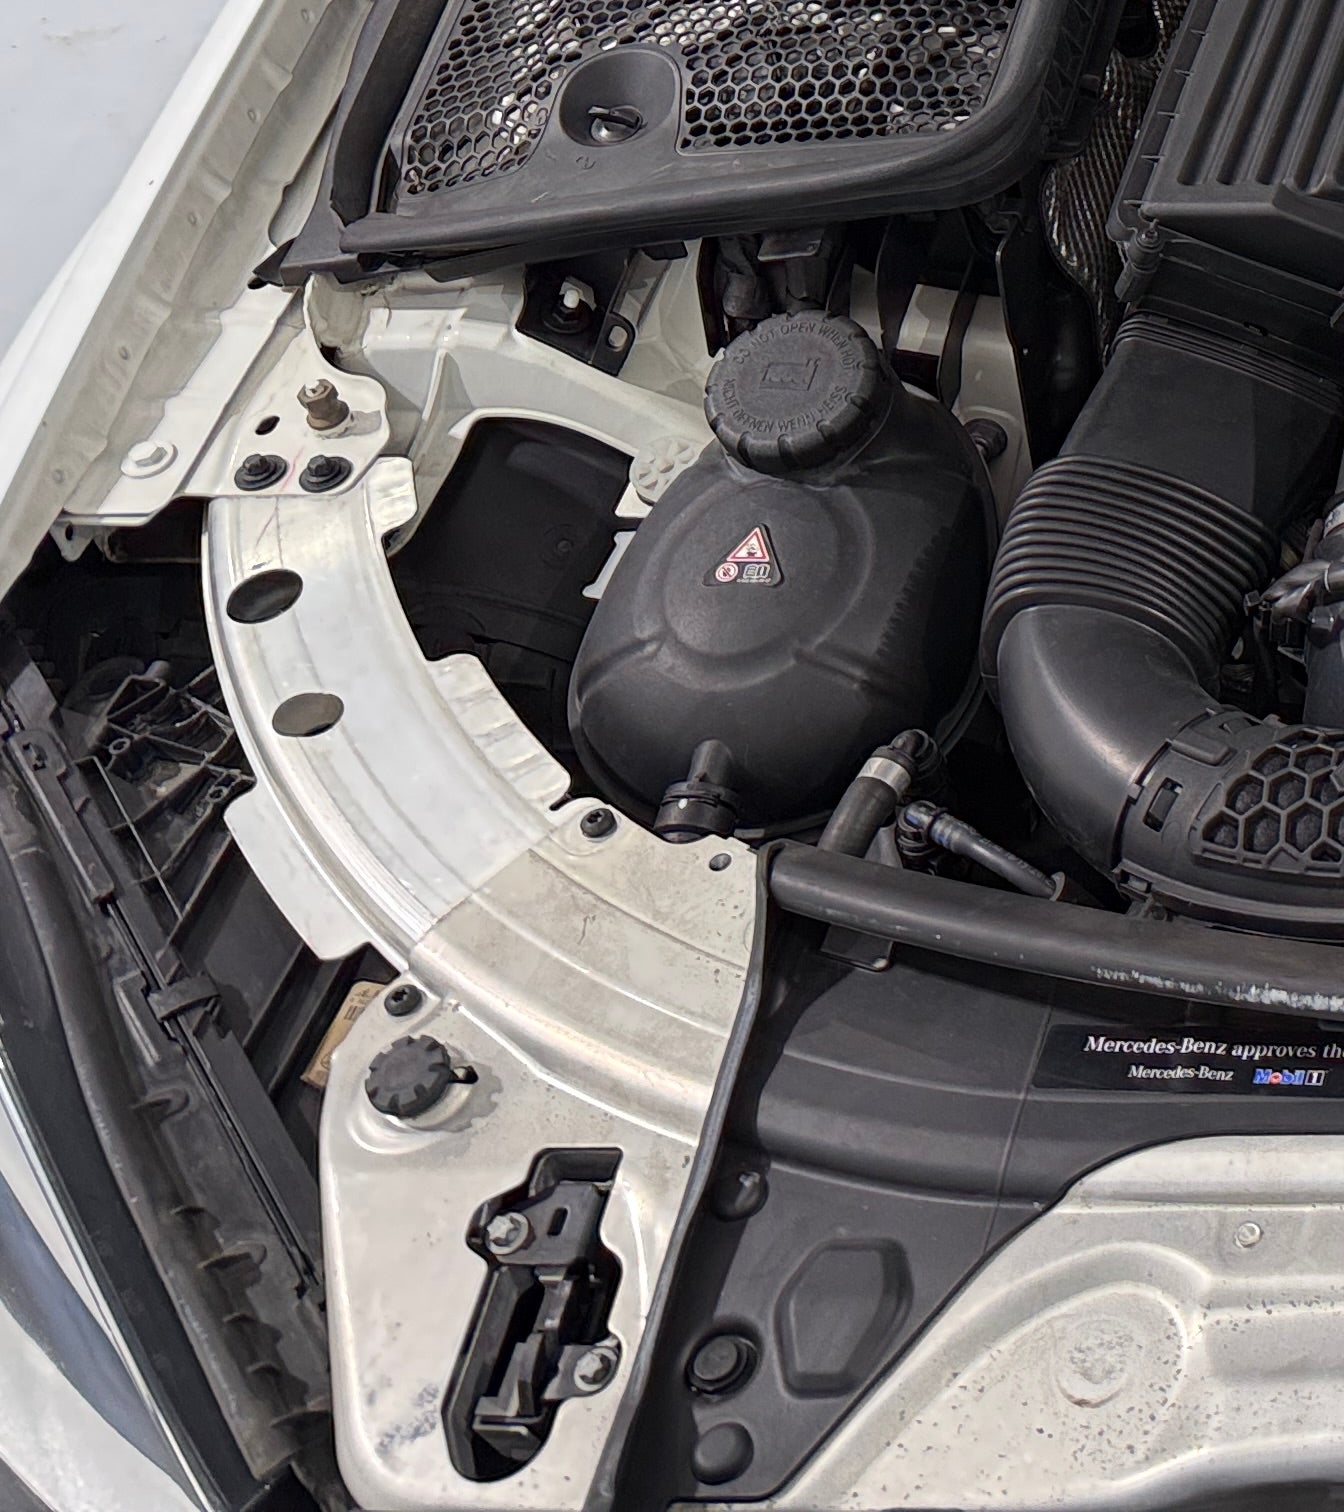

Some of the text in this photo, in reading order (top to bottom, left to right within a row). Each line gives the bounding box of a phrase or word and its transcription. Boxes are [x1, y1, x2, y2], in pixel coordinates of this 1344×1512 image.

[780, 320, 817, 336] OPEN
[818, 323, 849, 351] WHEN
[777, 412, 817, 433] WENN
[817, 384, 849, 416] HEISS
[1083, 1035, 1228, 1055] Mercedes-Benz
[1231, 1042, 1317, 1061] approves
[1127, 1064, 1235, 1081] Mercedes-Benz
[1252, 1068, 1306, 1086] Mobil
